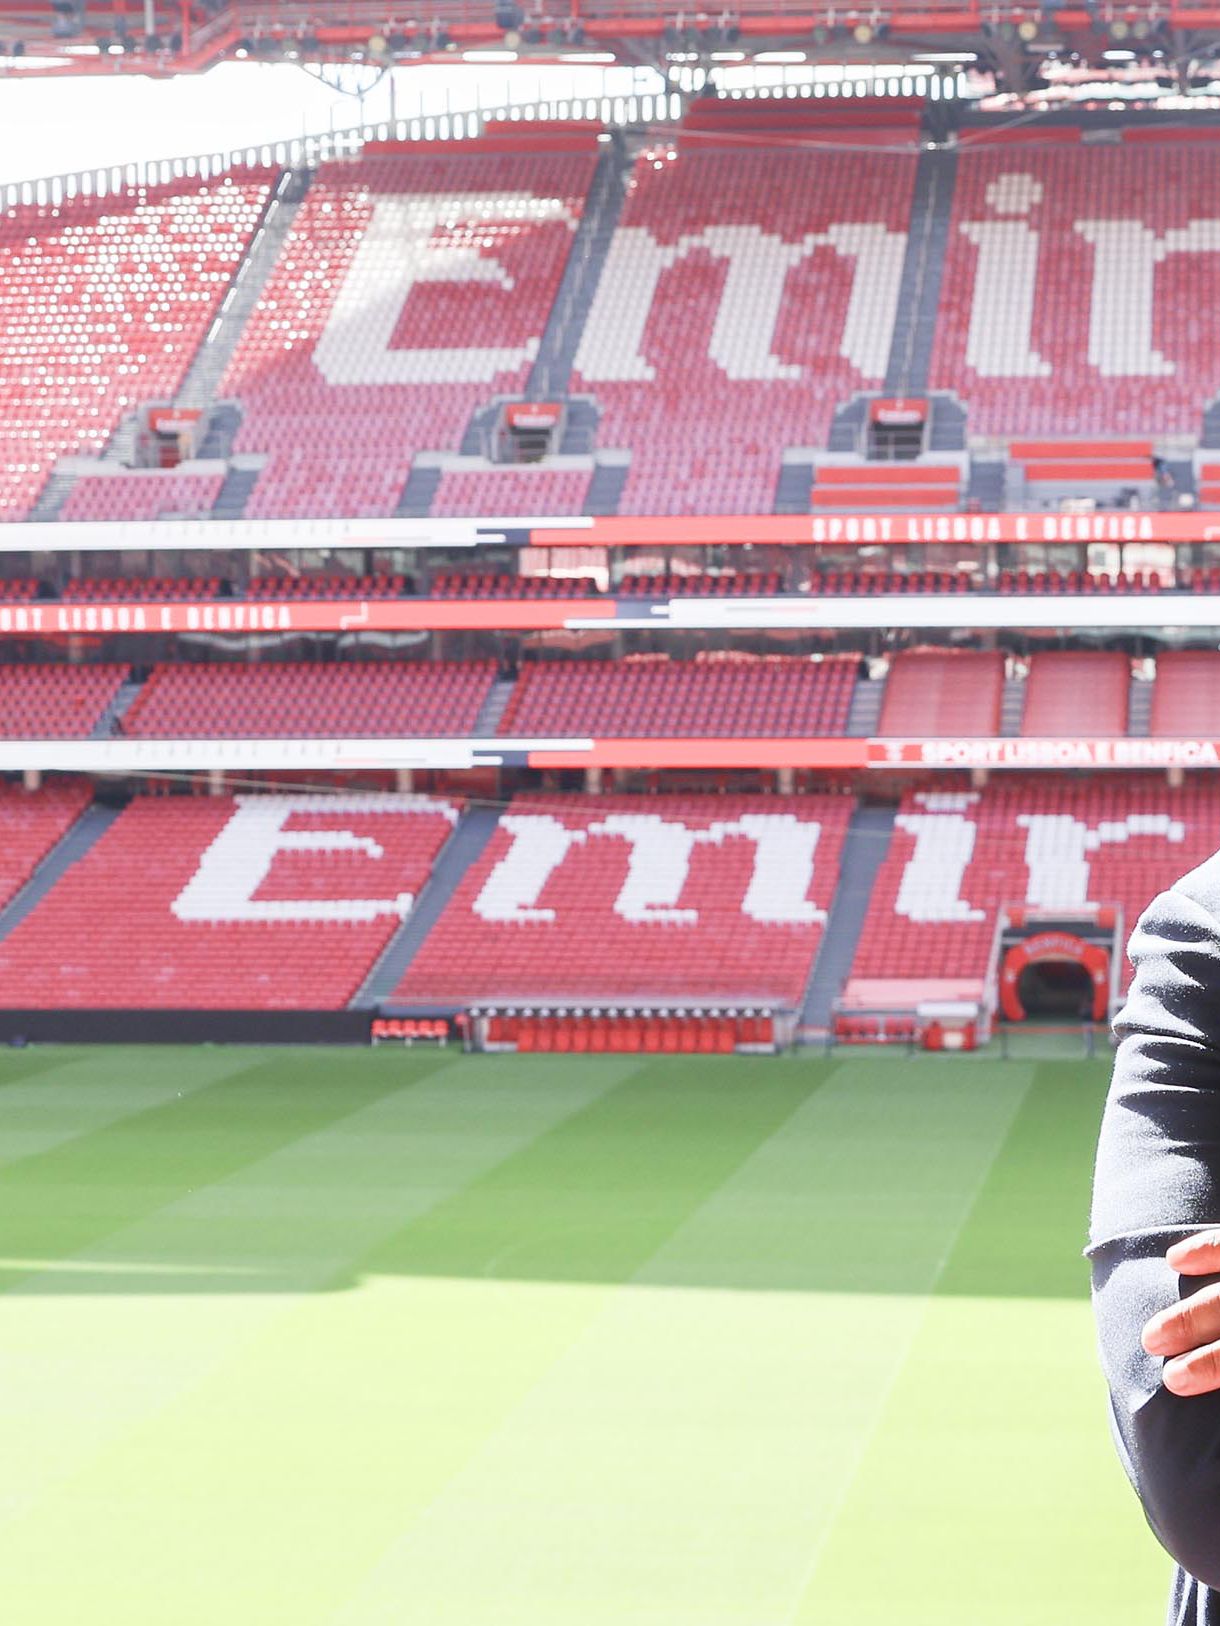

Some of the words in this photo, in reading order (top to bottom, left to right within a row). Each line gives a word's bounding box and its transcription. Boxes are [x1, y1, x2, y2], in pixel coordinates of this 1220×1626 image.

[812, 517, 892, 542] SPORT
[907, 517, 1001, 542] LISBOA
[1015, 517, 1029, 541] E
[1043, 516, 1153, 540] BENFICA
[58, 607, 146, 631] LISBOA
[187, 606, 291, 630] BENFICA
[921, 741, 1002, 763] SPORT
[1003, 741, 1092, 763] LISBOA
[1113, 741, 1218, 763] BENFICA
